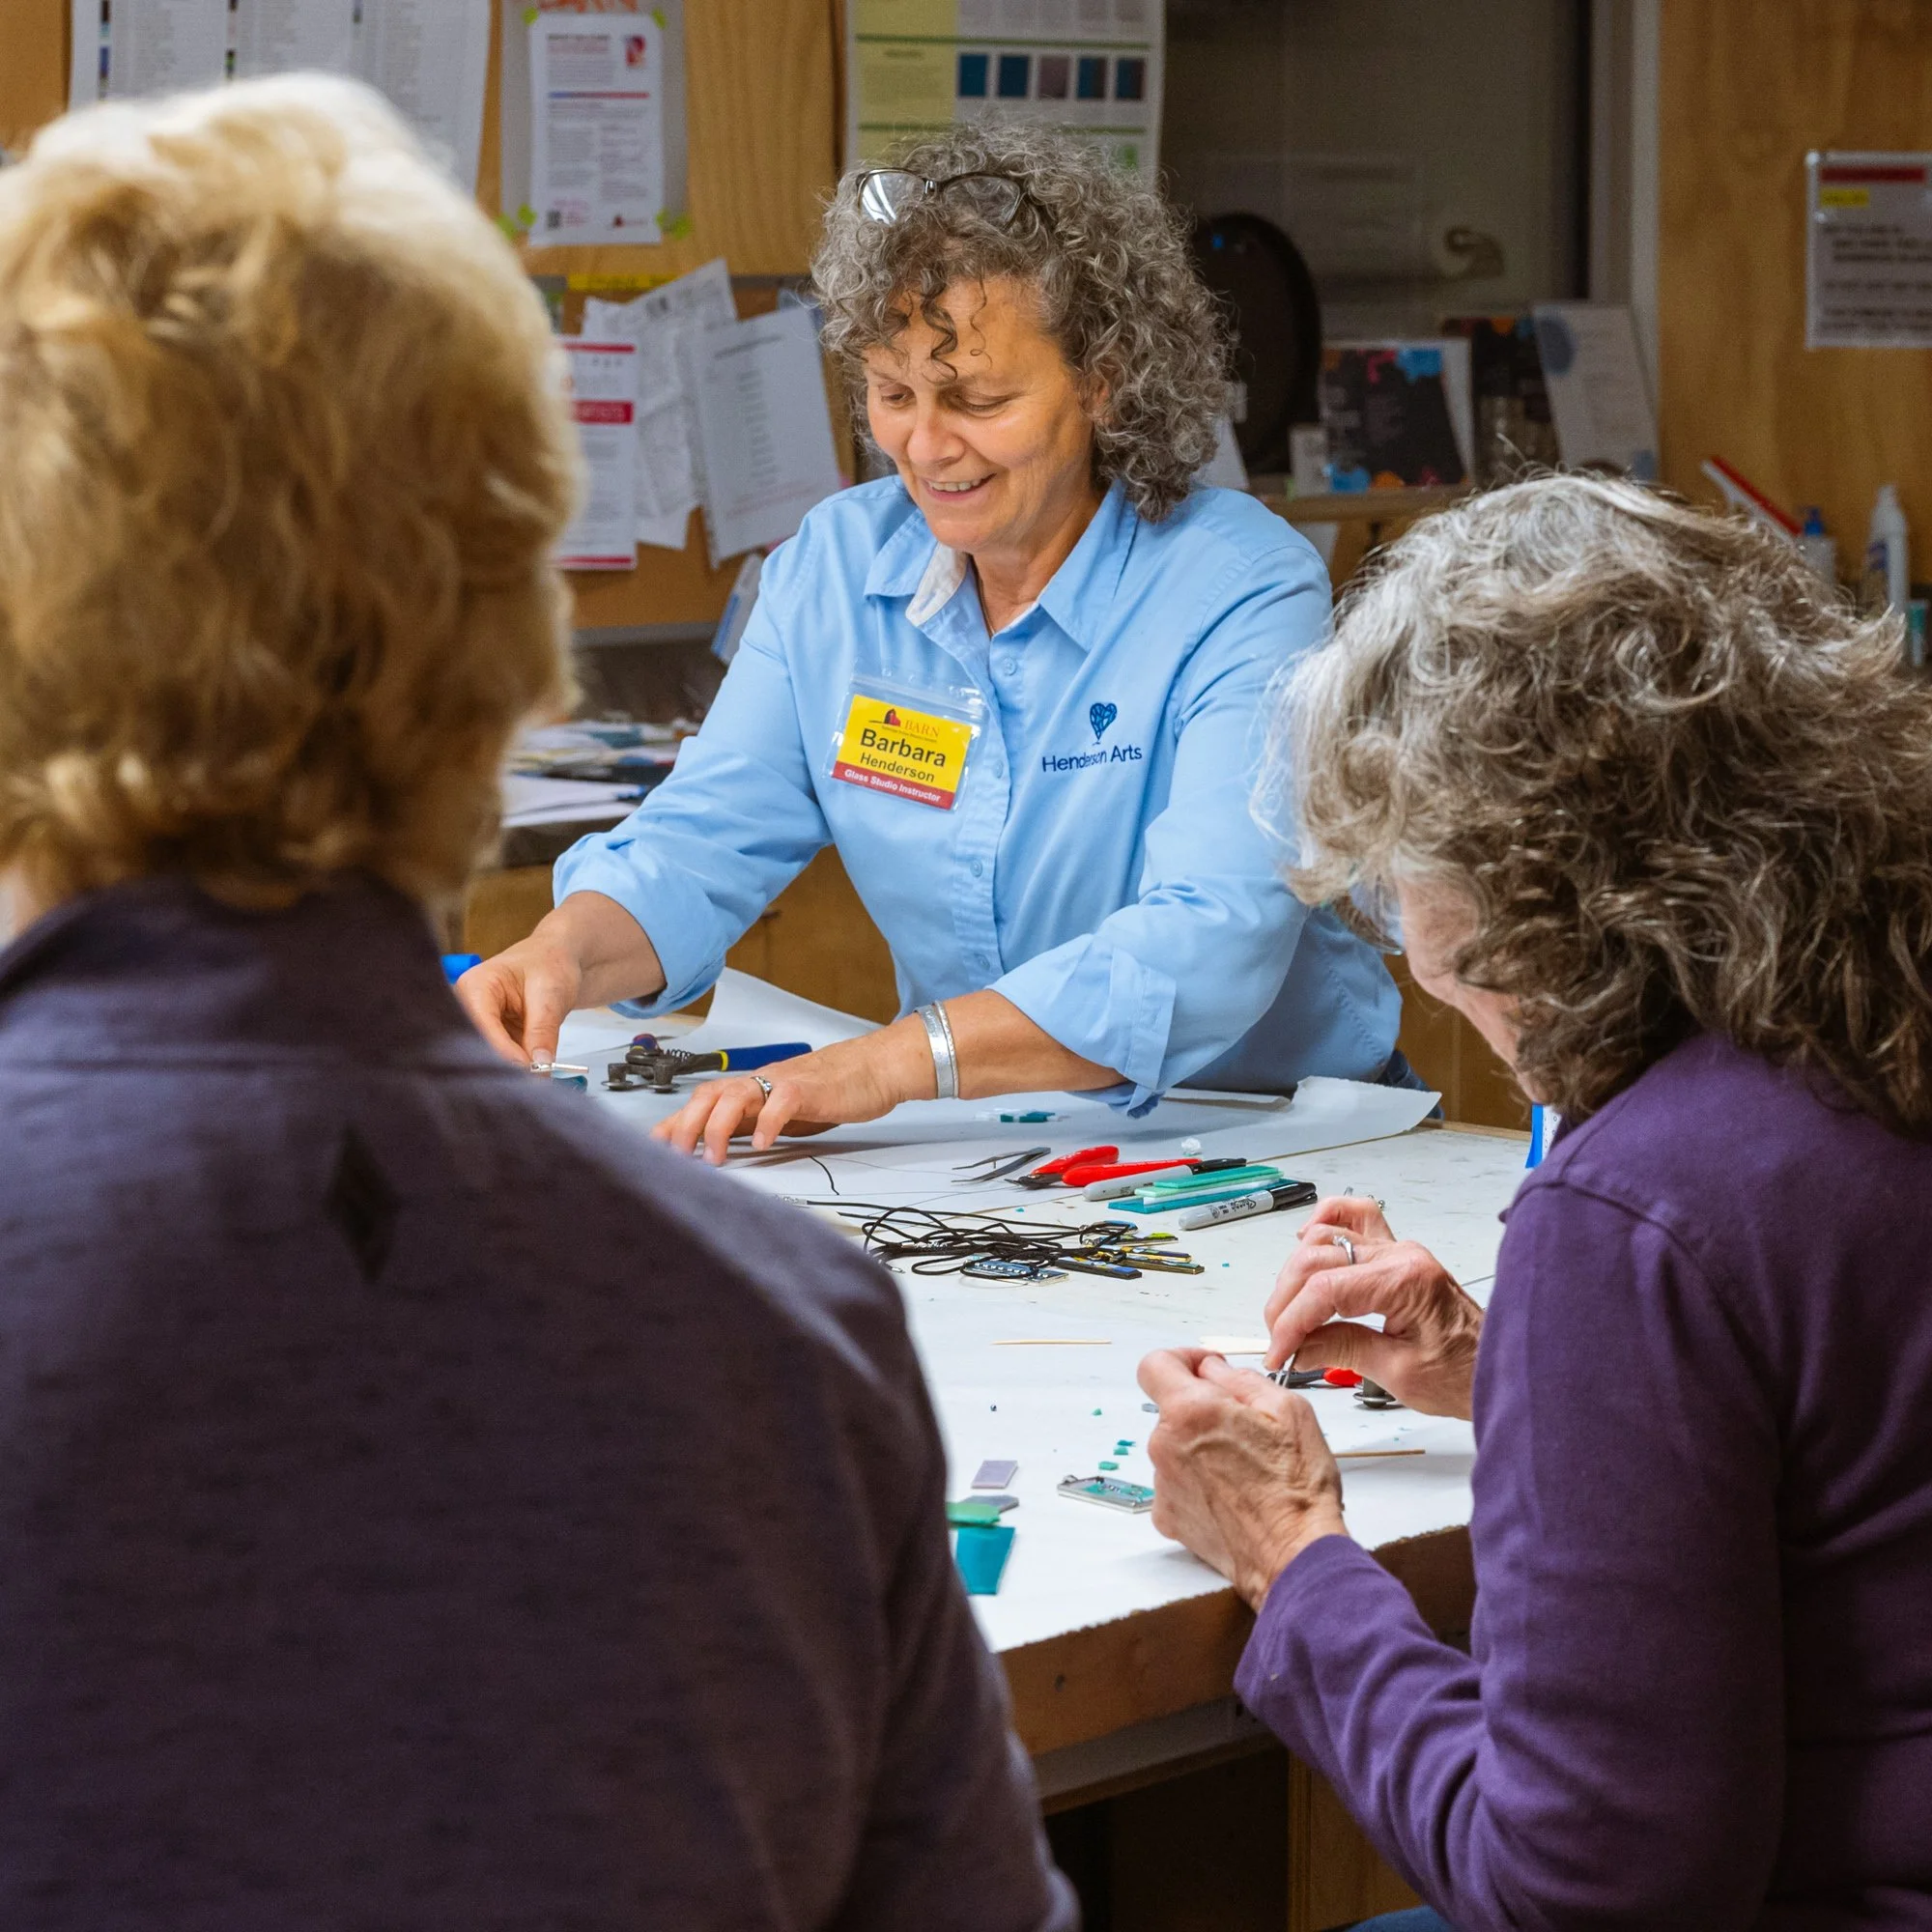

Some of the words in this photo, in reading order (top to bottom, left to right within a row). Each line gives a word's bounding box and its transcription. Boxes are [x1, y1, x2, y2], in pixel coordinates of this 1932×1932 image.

[904, 720, 940, 737] BARN
[860, 728, 947, 767] Barbara
[1110, 745, 1142, 762] Arts
[860, 752, 935, 782] Henderson
[844, 769, 868, 782] Glass
[870, 776, 898, 791] Studio
[898, 783, 941, 802] Instructor
